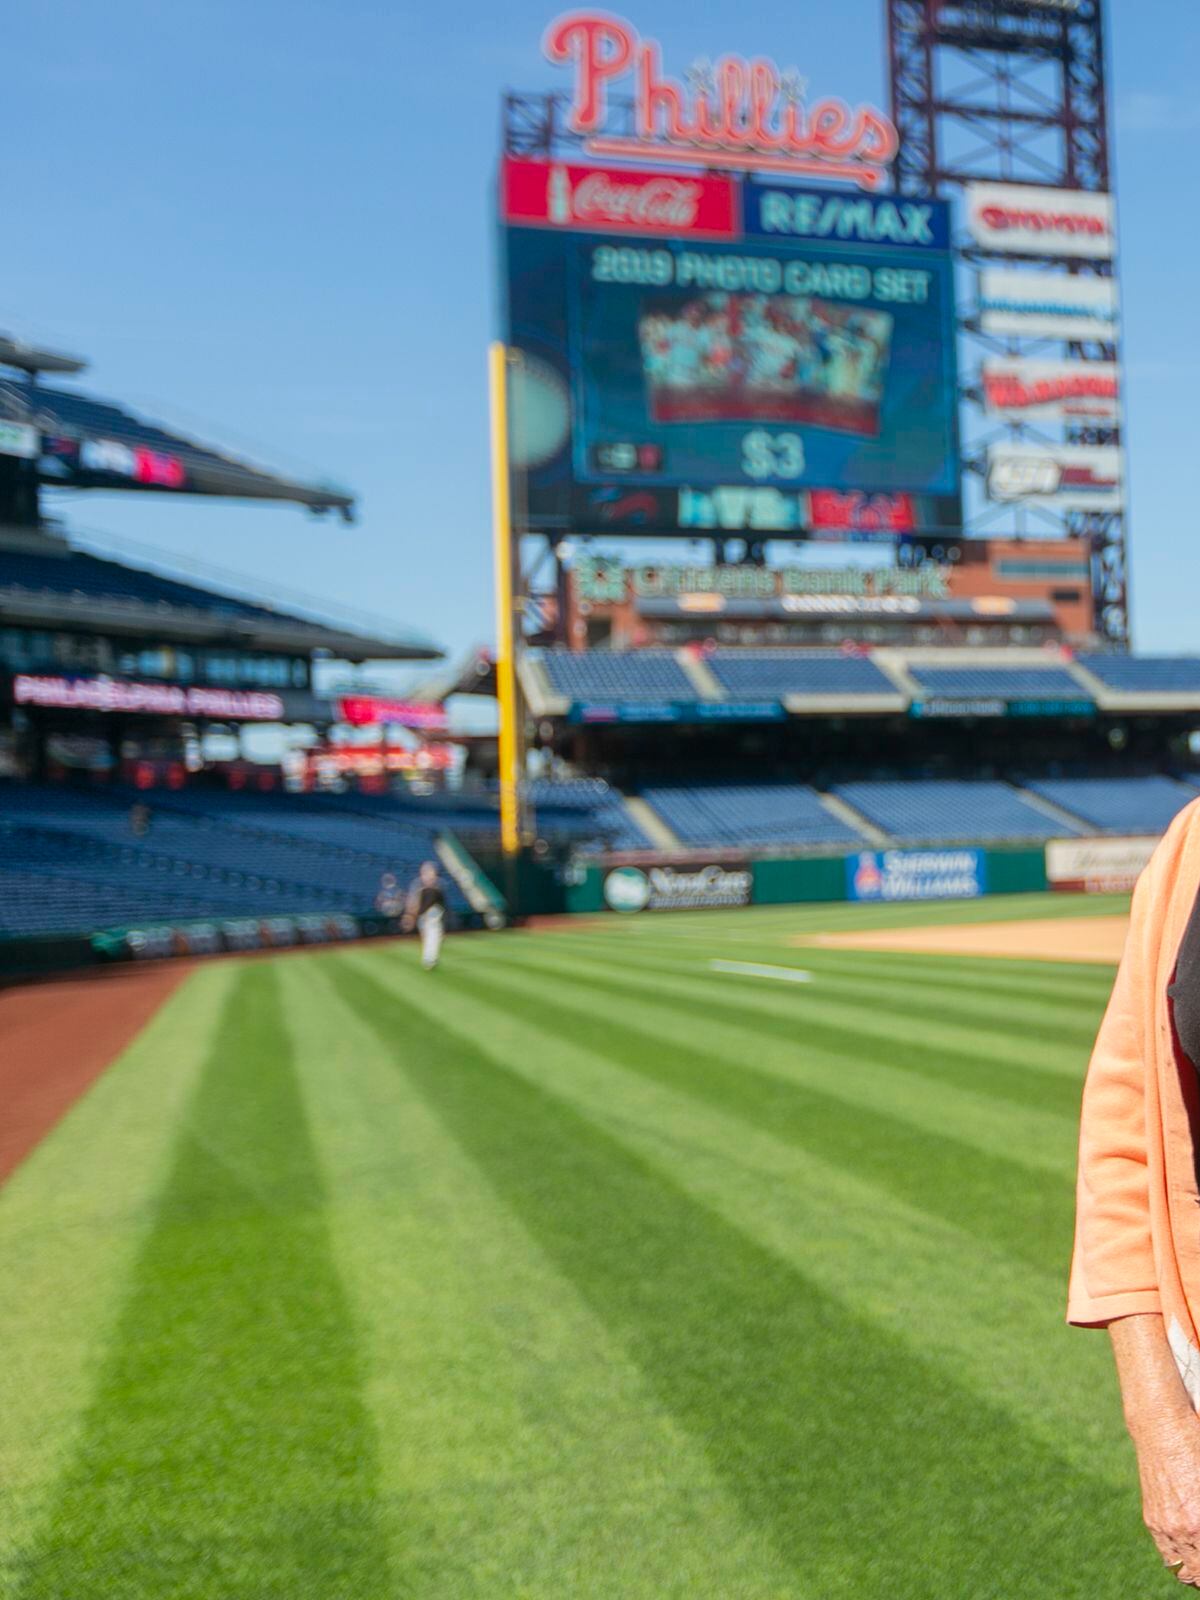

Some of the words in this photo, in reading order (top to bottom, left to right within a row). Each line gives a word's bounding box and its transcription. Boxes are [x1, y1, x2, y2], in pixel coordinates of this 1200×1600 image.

[546, 10, 898, 162] Phillies
[573, 173, 702, 228] Coca-Cola
[760, 190, 934, 243] RE/MAX
[592, 246, 674, 284] 2019
[676, 251, 781, 291] PHOTO
[784, 260, 872, 298] CARD
[873, 266, 931, 301] SET
[741, 430, 804, 479] $3
